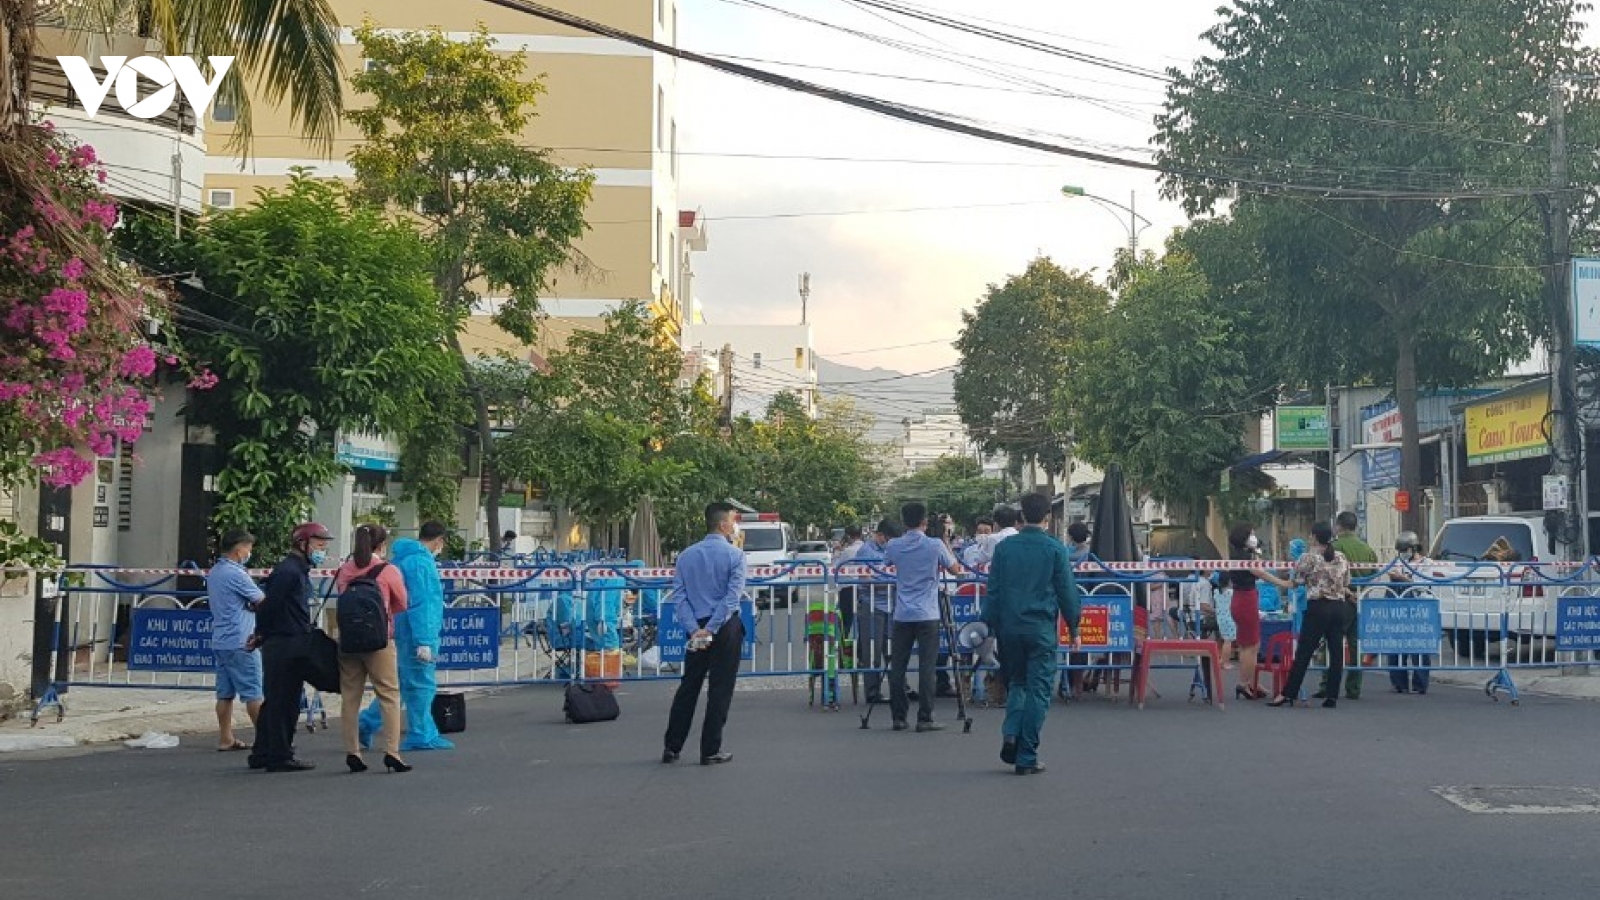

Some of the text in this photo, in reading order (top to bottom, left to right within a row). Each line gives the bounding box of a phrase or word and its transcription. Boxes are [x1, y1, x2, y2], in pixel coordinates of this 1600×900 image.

[1509, 420, 1543, 444] Tours
[1370, 604, 1430, 621] KHU VỰC CẤM
[147, 618, 168, 631] KHU
[172, 619, 194, 634] VỰC
[443, 613, 485, 632] ỰC CẤM
[666, 626, 684, 640] CÁC
[140, 636, 159, 648] CÁC
[161, 637, 199, 649] PHƯƠNG
[467, 634, 490, 648] TIỆN
[663, 645, 682, 656] GIAO
[134, 654, 153, 664] GIAO
[156, 652, 182, 665] THÔNG
